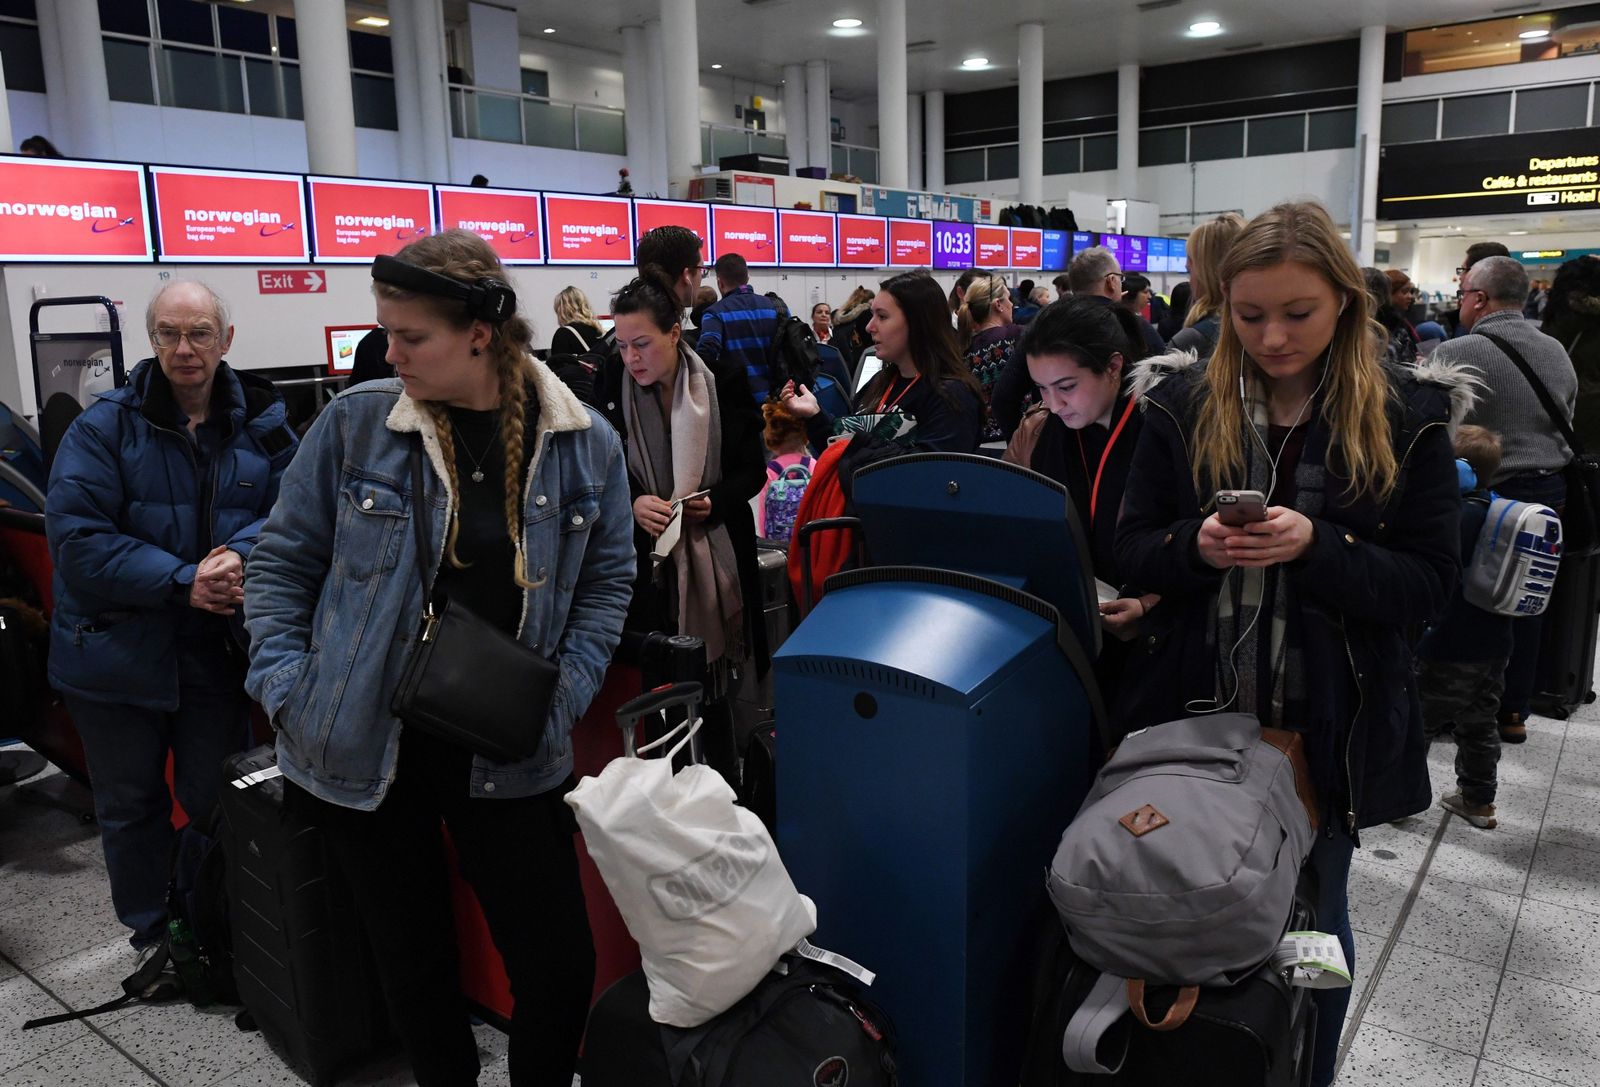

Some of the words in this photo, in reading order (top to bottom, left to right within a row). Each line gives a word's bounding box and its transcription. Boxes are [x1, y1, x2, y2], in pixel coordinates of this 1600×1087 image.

[1529, 156, 1599, 172] Departures
[1482, 175, 1516, 190] Cafés
[1516, 174, 1528, 188] &
[1529, 171, 1598, 187] restaurants
[1561, 189, 1597, 203] Hotel
[0, 202, 117, 221] norwegian
[184, 209, 281, 226] norwegian
[186, 225, 216, 234] European
[216, 225, 236, 234] flights
[335, 215, 414, 230] norwegian
[458, 220, 525, 234] norwegian
[186, 233, 198, 242] bag
[199, 233, 215, 242] drop
[562, 224, 618, 237] norwegian
[724, 231, 767, 242] norwegian
[789, 234, 827, 244] norwegian
[936, 231, 972, 254] 10:33
[158, 272, 170, 280] 19
[261, 273, 293, 289] Exit
[590, 271, 598, 279] 22
[63, 357, 104, 369] norwegian
